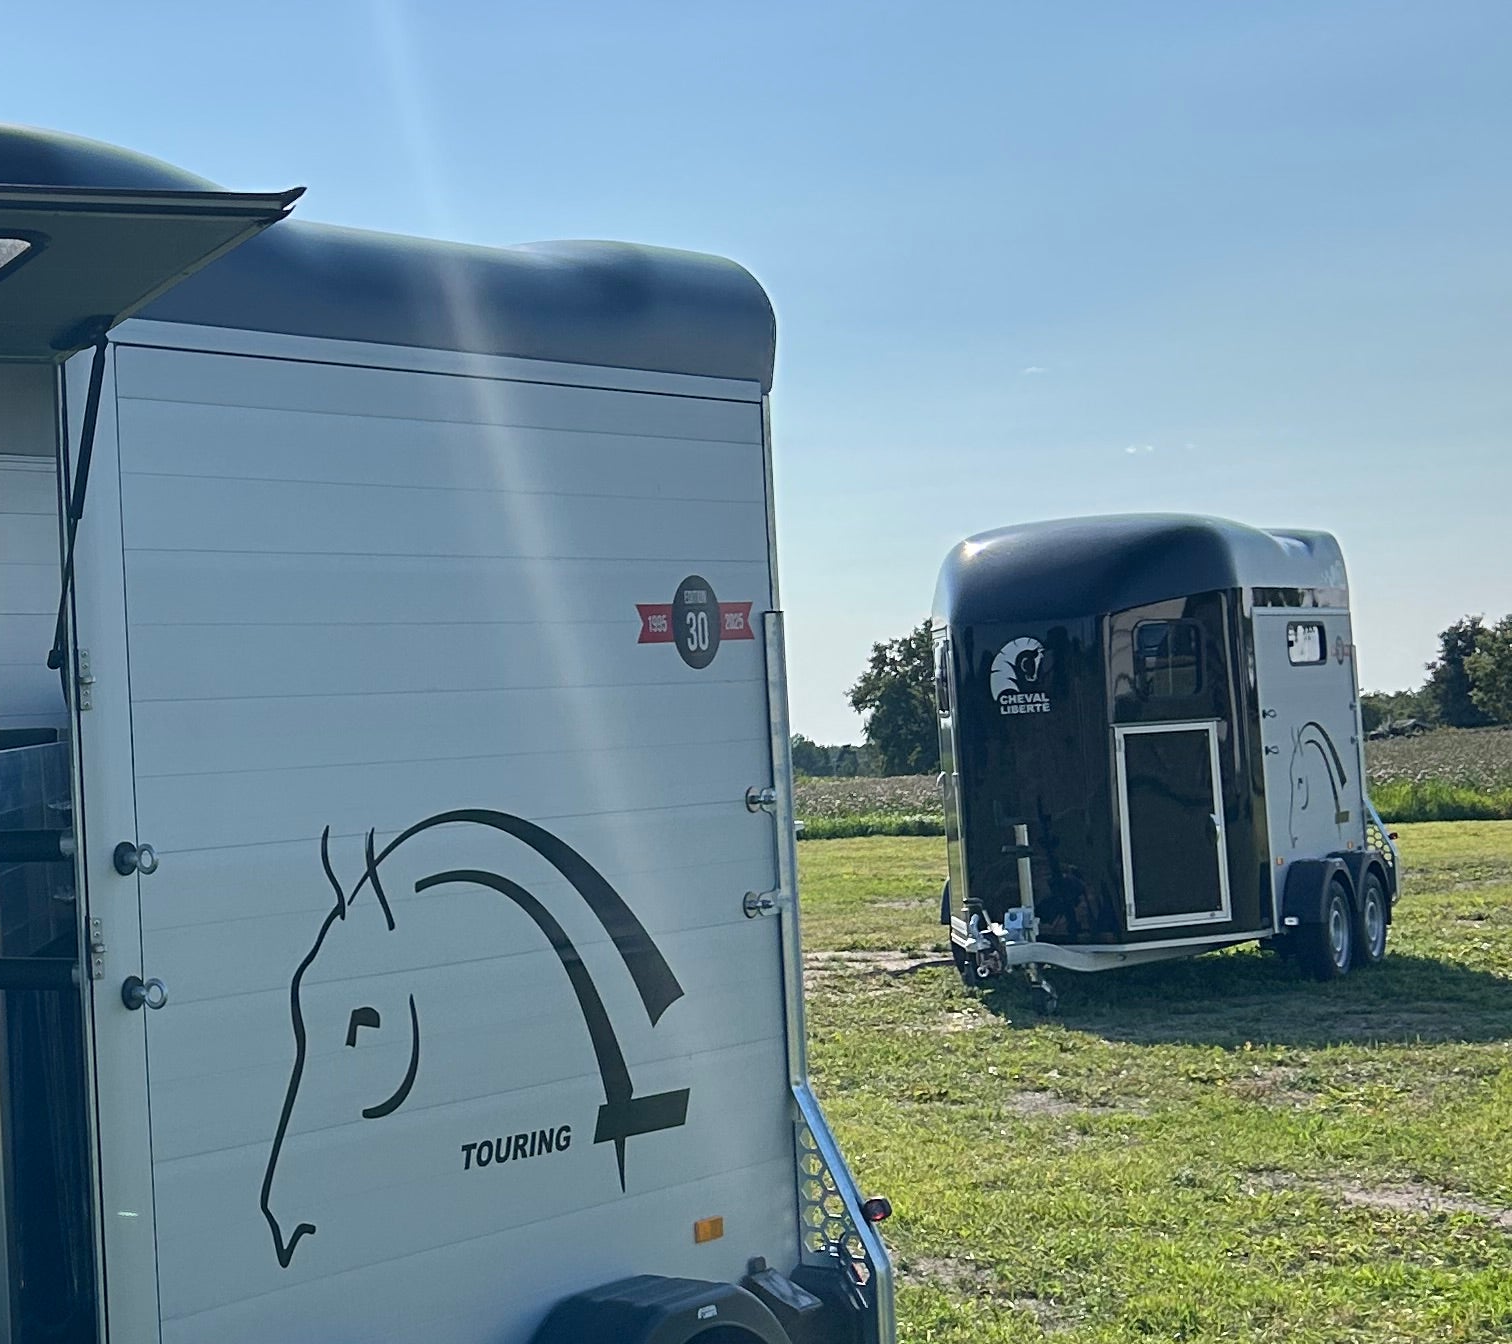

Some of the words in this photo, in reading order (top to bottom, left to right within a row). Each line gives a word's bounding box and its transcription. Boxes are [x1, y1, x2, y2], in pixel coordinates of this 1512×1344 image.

[686, 611, 710, 652] 30
[999, 692, 1050, 705] CHEVAL
[461, 1124, 572, 1171] TOURING
